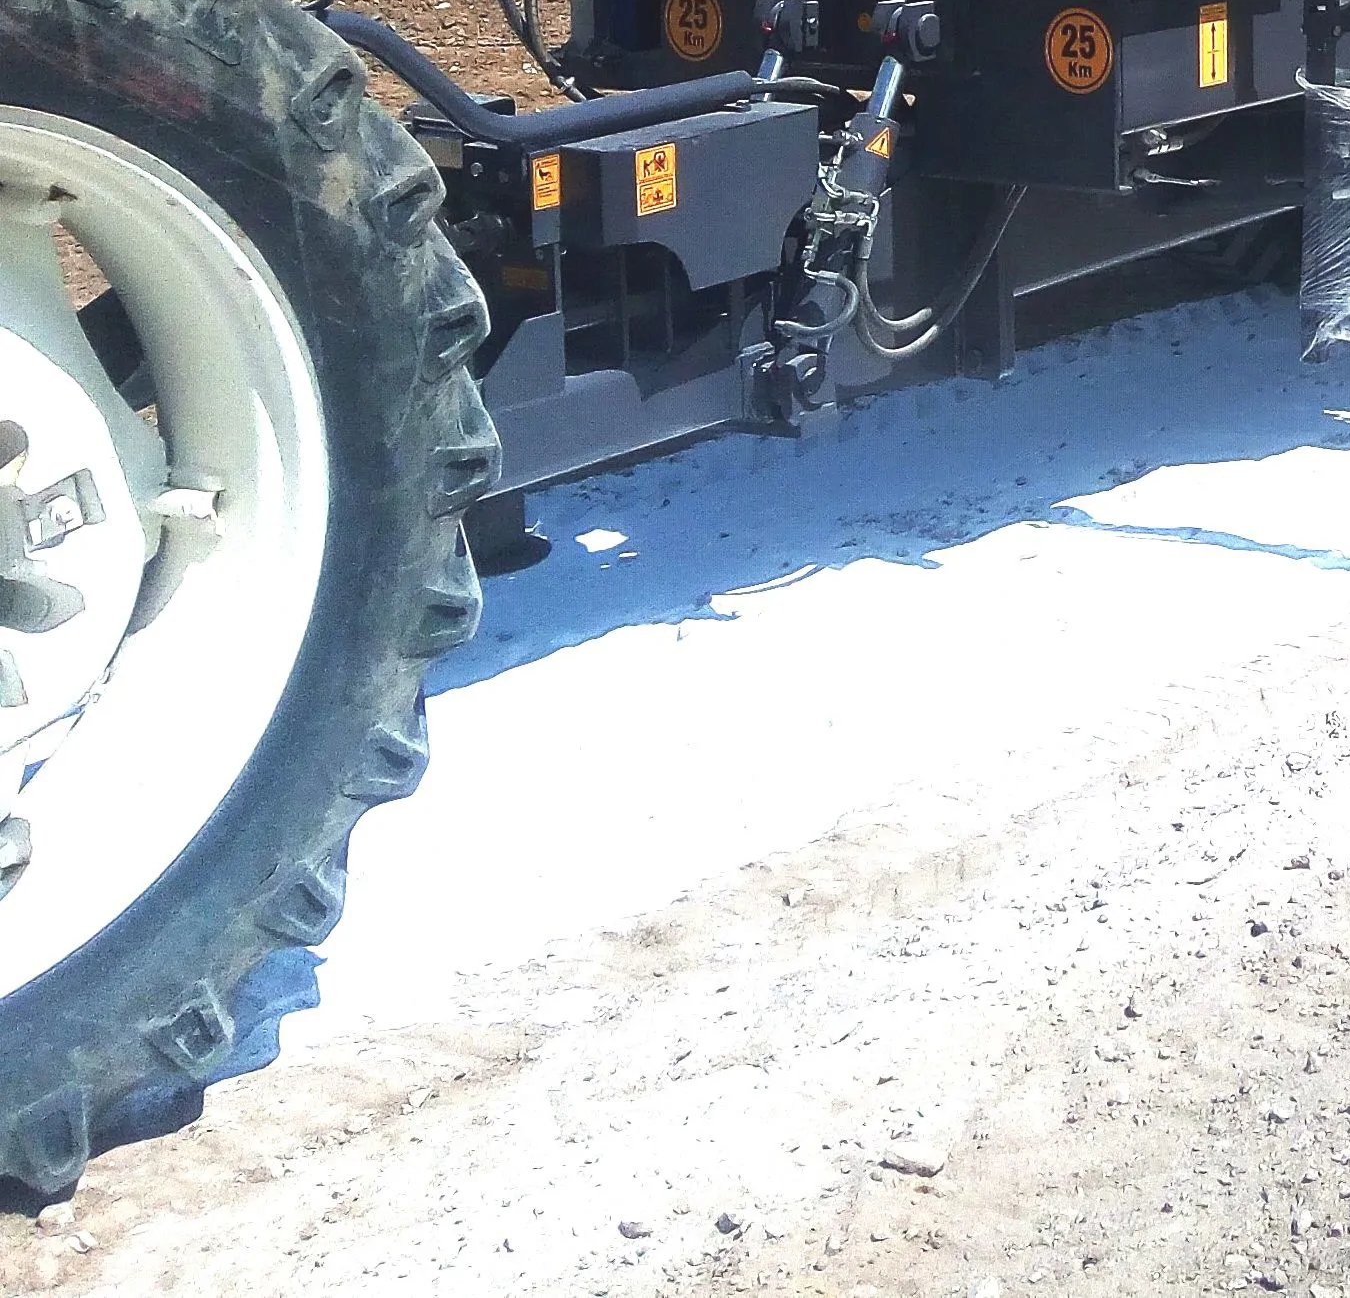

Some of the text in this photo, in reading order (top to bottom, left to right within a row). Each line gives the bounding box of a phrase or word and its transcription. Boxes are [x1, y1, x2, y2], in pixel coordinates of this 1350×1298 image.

[683, 30, 705, 48] Km
[1060, 23, 1097, 60] 25
[1068, 61, 1093, 78] Km
